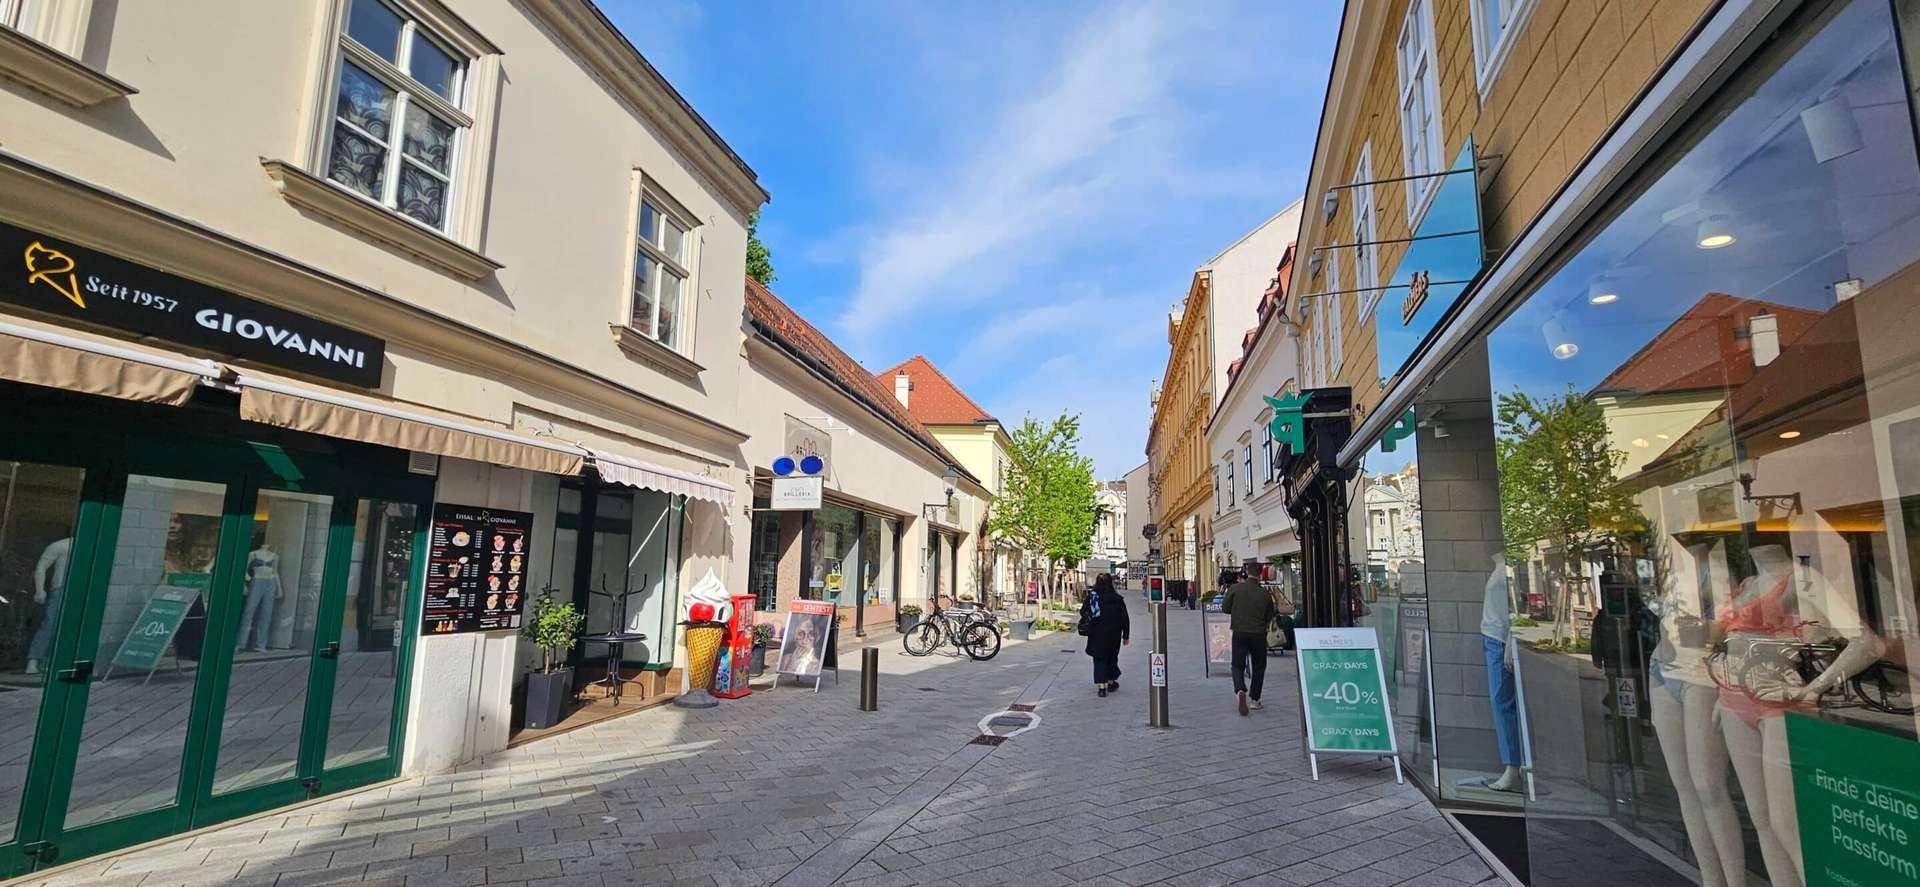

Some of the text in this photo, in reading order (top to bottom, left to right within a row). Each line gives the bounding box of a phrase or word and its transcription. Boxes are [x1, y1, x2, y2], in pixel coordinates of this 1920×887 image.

[85, 275, 179, 313] Seit 1957
[195, 308, 366, 369] GIOVANNI
[1312, 662, 1369, 670] CRAZY DAYS
[1312, 682, 1378, 705] -40%
[1322, 727, 1380, 737] CRAZY DAYS
[1815, 768, 1919, 820] Finde deine
[1831, 803, 1908, 846] perfekte
[1832, 825, 1918, 880] Passform
